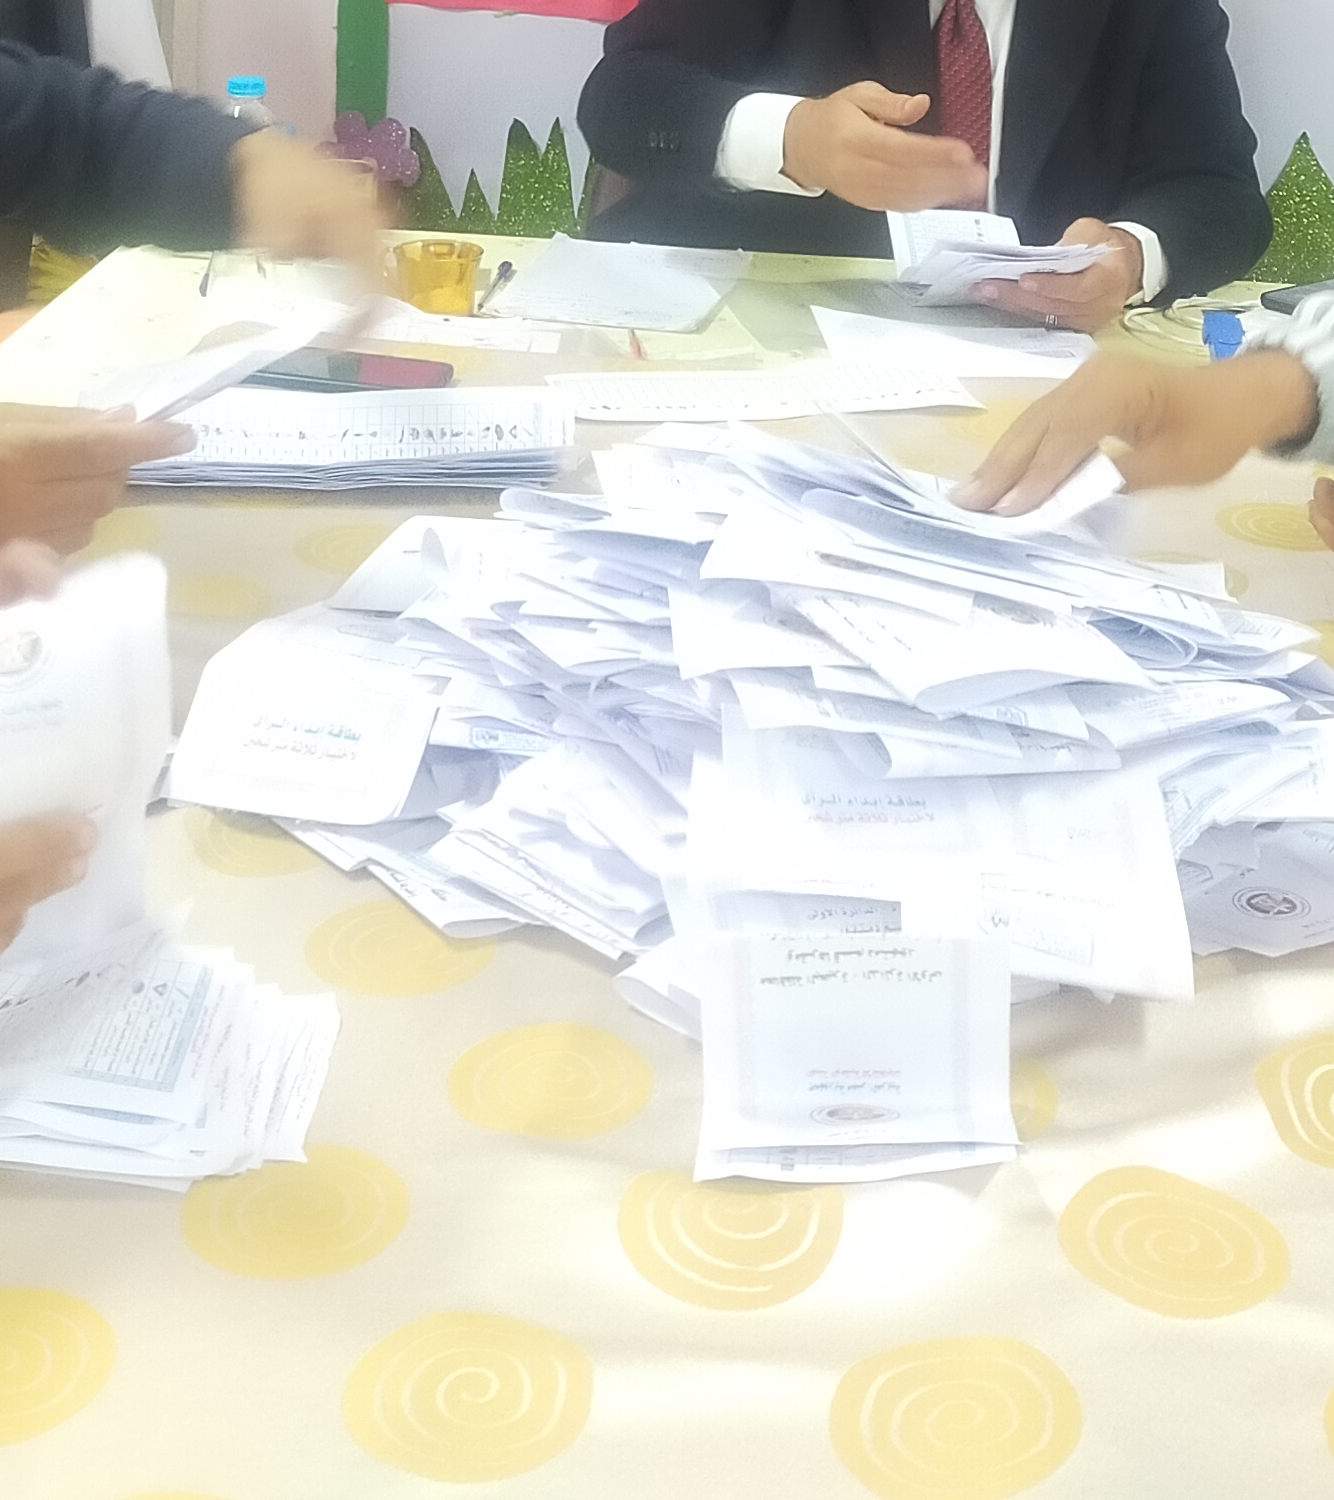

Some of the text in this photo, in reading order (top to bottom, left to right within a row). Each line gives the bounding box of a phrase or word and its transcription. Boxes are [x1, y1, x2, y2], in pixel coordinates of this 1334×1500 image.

[328, 724, 362, 744] بطاقة
[887, 793, 927, 809] بطاقة
[833, 948, 865, 964] قسم
[868, 948, 915, 961] دمنهور
